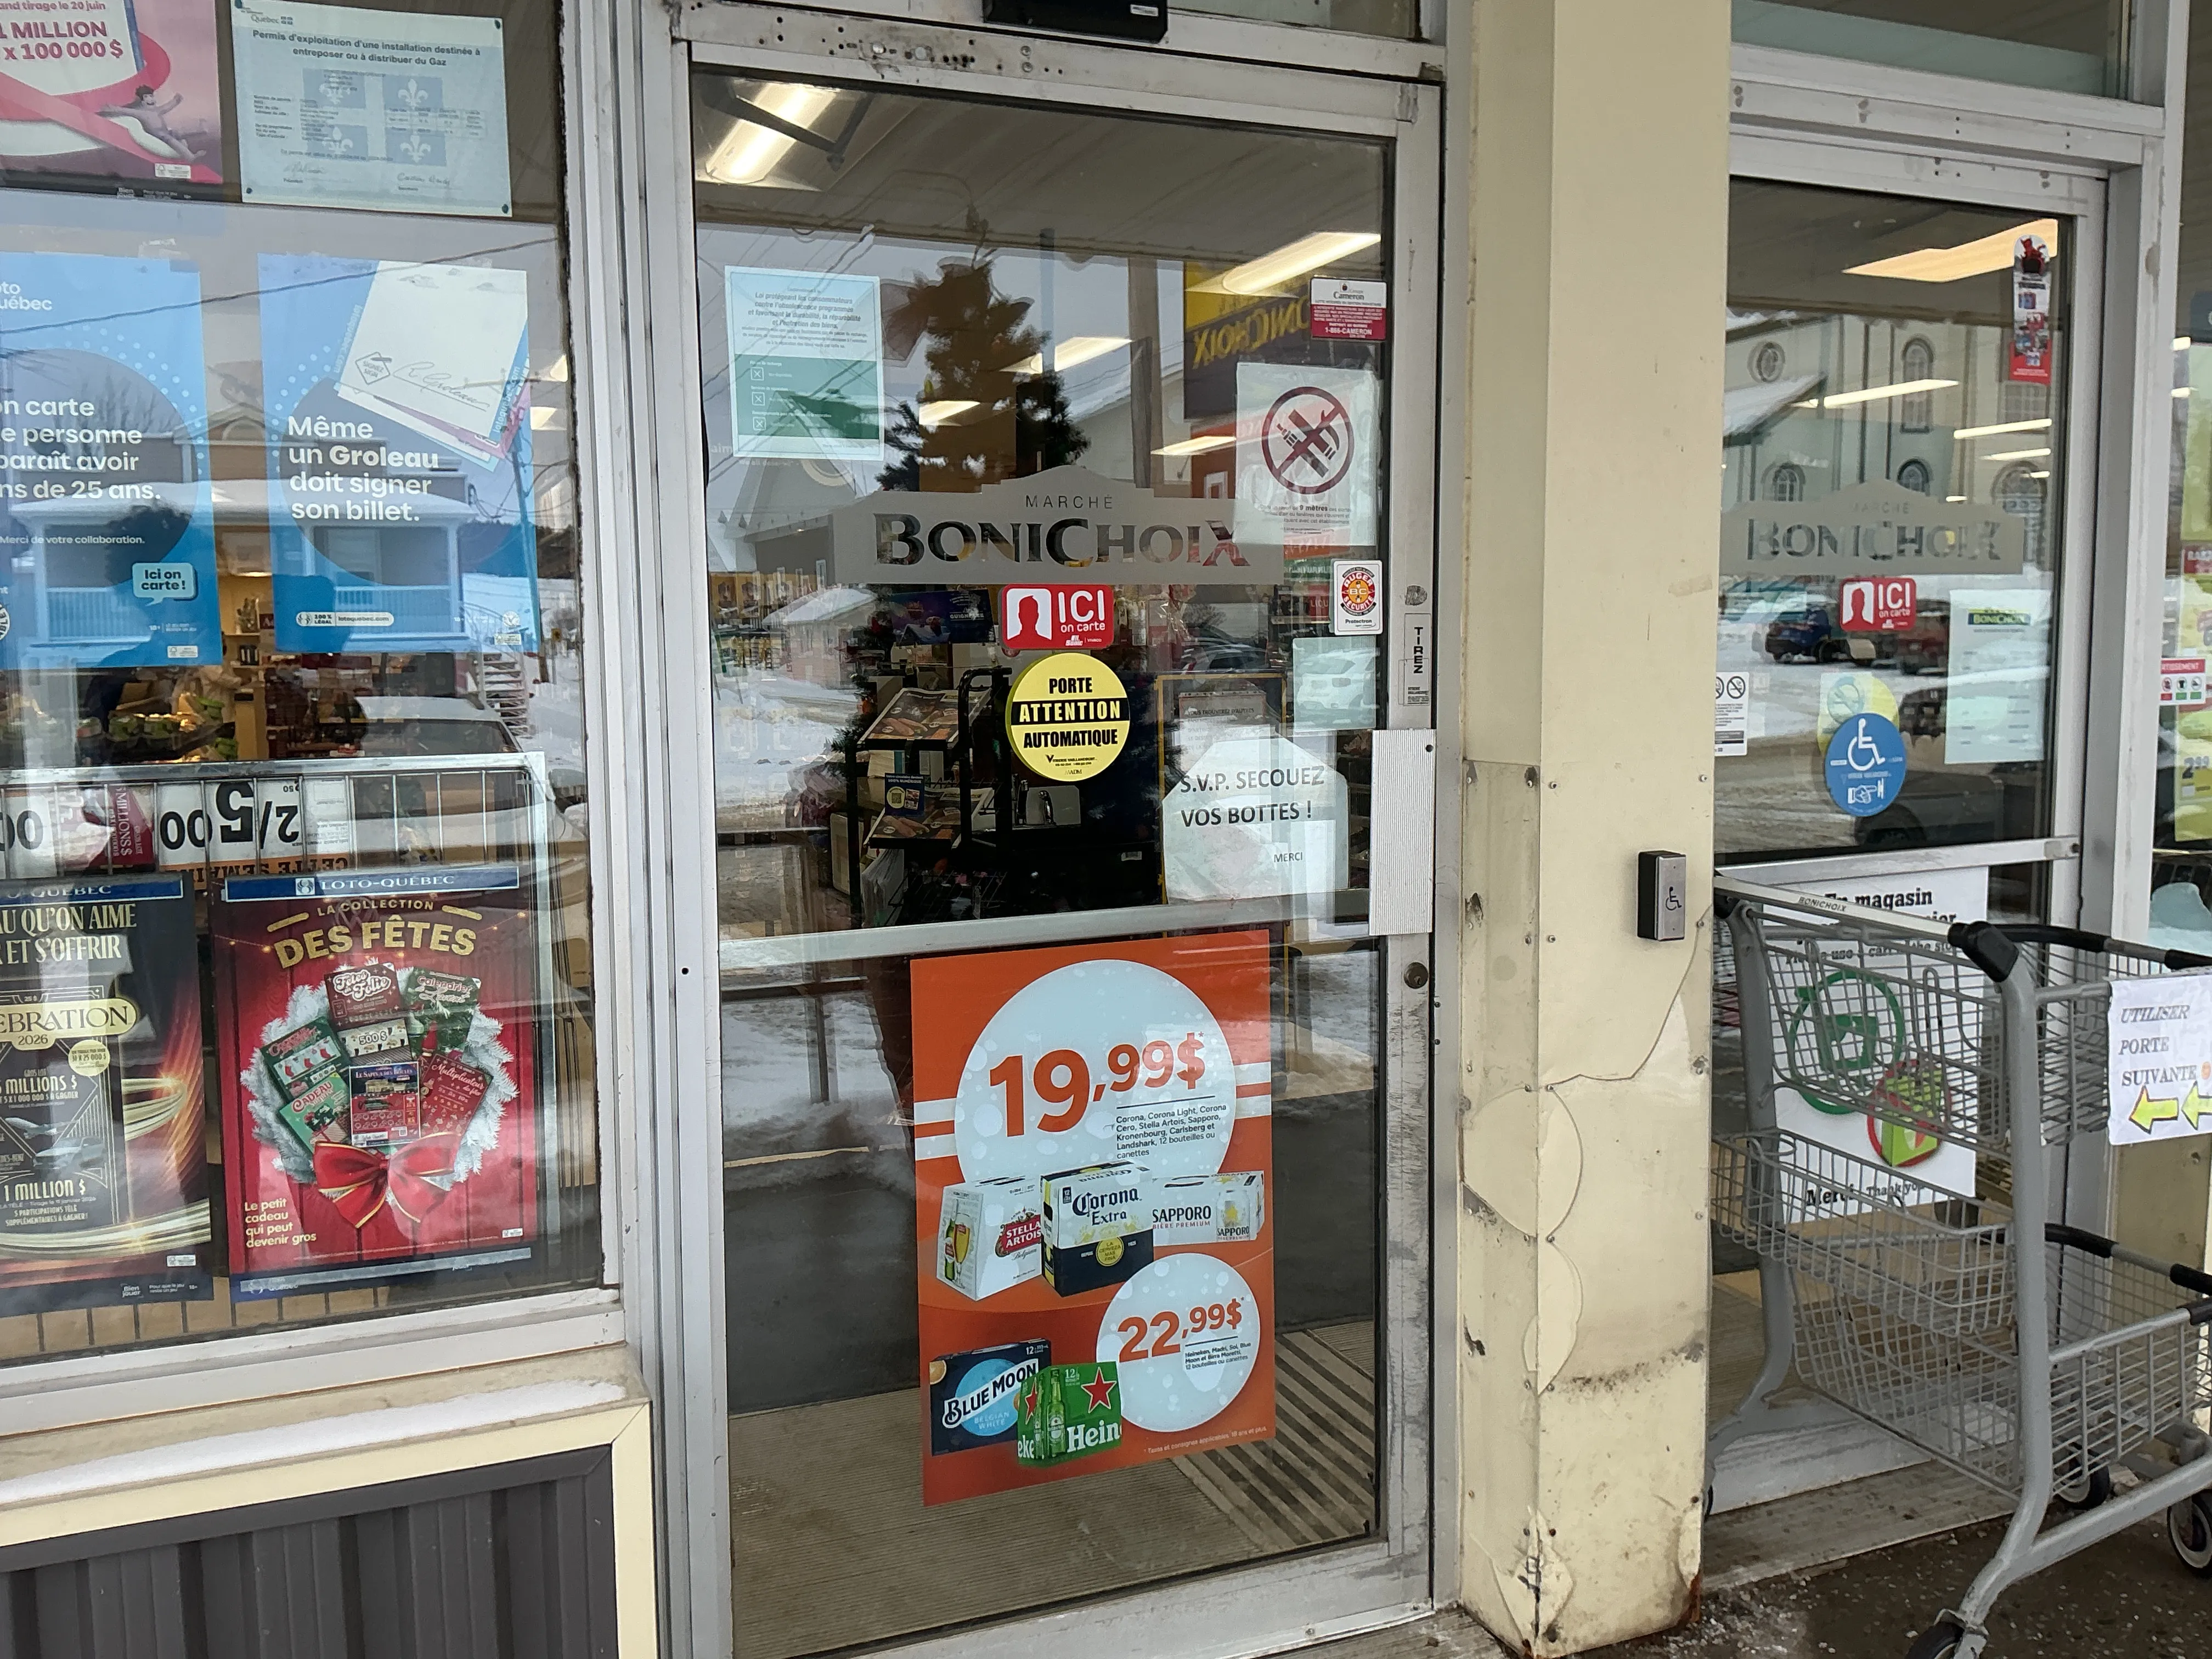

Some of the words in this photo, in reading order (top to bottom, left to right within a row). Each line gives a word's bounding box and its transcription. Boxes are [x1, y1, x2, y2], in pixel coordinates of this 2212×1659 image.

[22, 2, 56, 13] tirage
[59, 1, 69, 10] le
[86, 1, 106, 12] juin
[11, 21, 107, 38] MILLION
[4, 47, 17, 60] x
[22, 42, 63, 59] 100
[67, 41, 106, 58] 000
[109, 39, 124, 59] $
[253, 30, 286, 40] Permis
[289, 34, 352, 47] d'exploitation
[354, 40, 379, 49] d'une
[382, 42, 432, 52] installation
[435, 46, 472, 55] destinée
[293, 48, 343, 58] entreposer
[369, 54, 413, 64] distribuer
[430, 58, 447, 66] Gaz
[1333, 291, 1364, 301] Cameron
[25, 398, 94, 416] carte
[287, 415, 373, 438] Même
[22, 428, 142, 446] personne
[77, 452, 139, 471] avoir
[289, 447, 323, 464] un
[329, 445, 439, 469] Groleau
[33, 480, 66, 498] de
[70, 481, 102, 499] 25
[109, 485, 161, 499] ans.
[289, 472, 345, 493] doit
[349, 472, 432, 497] signer
[292, 502, 339, 519] son
[347, 499, 420, 522] billet.
[1026, 494, 1113, 509] MARCHÉ
[1, 536, 29, 544] Merci
[31, 536, 44, 544] de
[75, 535, 145, 544] collaboration.
[873, 512, 1251, 567] BONICHOIX
[145, 569, 161, 579] Ici
[164, 571, 181, 579] on
[1878, 582, 1910, 610] ICI
[1058, 590, 1105, 623] ICI
[1060, 624, 1074, 633] on
[1077, 621, 1105, 632] carte
[1413, 627, 1423, 674] TIREZ
[1049, 677, 1093, 694] PORTE
[1019, 700, 1120, 723] ATTENTION
[1023, 729, 1118, 749] AUTOMATIQUE
[1180, 771, 1229, 793] S.V.P.
[1237, 765, 1325, 790] SECOUEZ
[1181, 807, 1222, 827] VOS
[1228, 802, 1300, 824] BOTTES
[1273, 852, 1303, 863] MERCI
[318, 904, 336, 916] LA
[341, 899, 433, 912] COLLECTION
[1798, 895, 1847, 913] BONICHOIX
[21, 906, 83, 936] QU'ON
[89, 904, 137, 929] AIME
[6, 940, 32, 964] ET
[35, 935, 122, 962] S'OFFRIR
[274, 926, 353, 969] DES
[361, 915, 476, 956] FÊTES
[2120, 1005, 2190, 1024] UTILISER
[18, 1034, 48, 1046] 2026
[359, 1032, 379, 1045] 500
[380, 1030, 387, 1041] $
[2118, 1036, 2170, 1056] PORTE
[5, 1075, 66, 1094] MILLIONS
[71, 1075, 77, 1089] $
[2121, 1065, 2197, 1087] SUIVANTE
[292, 1081, 333, 1113] CADEAU
[1116, 1115, 1146, 1124] Corona,
[1148, 1111, 1175, 1120] Corona
[1177, 1107, 1198, 1117] Light,
[1200, 1104, 1227, 1113] Corona
[1116, 1125, 1137, 1133] Cero,
[1139, 1121, 1160, 1130] Stella
[1162, 1118, 1186, 1127] Artois,
[1188, 1115, 1221, 1125] Sapporo,
[1116, 1130, 1167, 1142] Kronenbourg,
[1169, 1125, 1205, 1135] Carlsberg
[1117, 1140, 1157, 1150] Landshark,
[1169, 1133, 1204, 1144] bouteilles
[1116, 1149, 1149, 1159] canettes
[4, 1185, 9, 1201] 1
[15, 1180, 74, 1200] MILLION
[79, 1178, 86, 1195] $
[245, 1202, 257, 1211] Le
[261, 1199, 286, 1212] petit
[1073, 1187, 1142, 1217] Corona
[245, 1211, 288, 1223] cadeau
[1091, 1210, 1127, 1227] Extra
[1152, 1205, 1211, 1223] SAPPORO
[246, 1223, 264, 1235] qui
[267, 1222, 293, 1235] peut
[1006, 1220, 1041, 1239] STELLA
[1176, 1220, 1210, 1229] PREMIUM
[1216, 1225, 1249, 1237] SAPPORO
[246, 1234, 289, 1248] devenir
[292, 1233, 317, 1245] gros
[1006, 1229, 1042, 1249] ARTOIS
[1026, 1346, 1034, 1355] 12
[1185, 1356, 1200, 1364] Moon
[1192, 1359, 1216, 1369] bouteilles
[1226, 1355, 1248, 1363] canettes
[1065, 1368, 1075, 1379] 12
[945, 1387, 990, 1426] BLUE
[992, 1362, 1036, 1400] MOON
[974, 1410, 1010, 1424] BELGIAN
[978, 1419, 1005, 1429] WHITE
